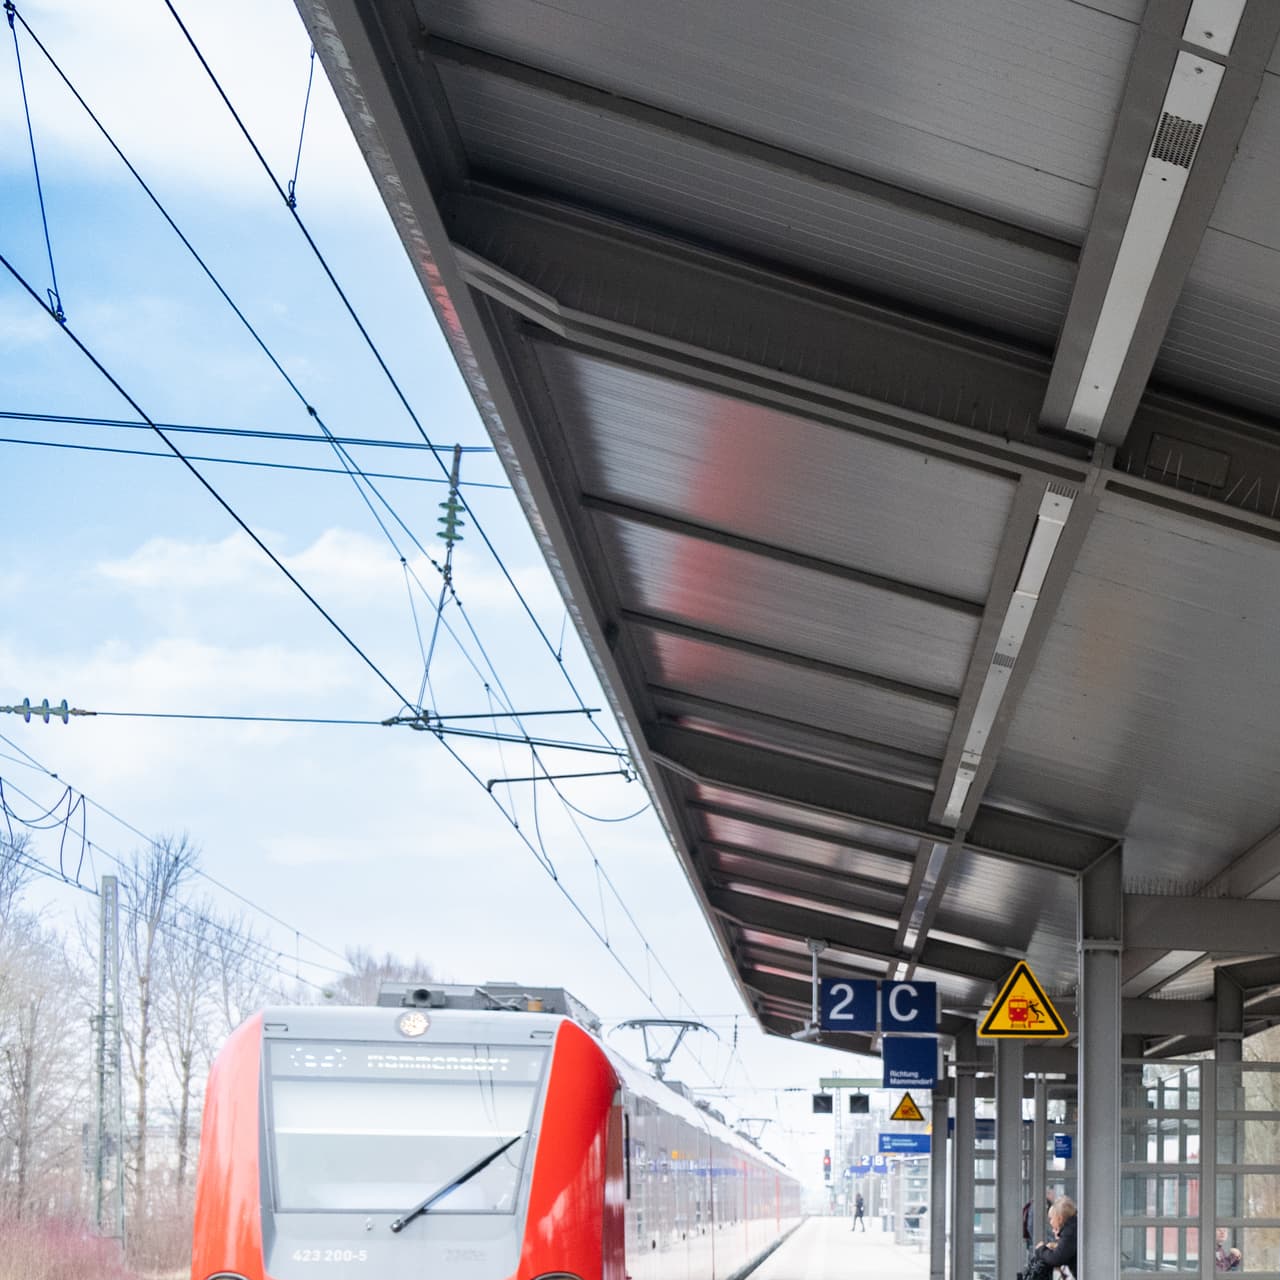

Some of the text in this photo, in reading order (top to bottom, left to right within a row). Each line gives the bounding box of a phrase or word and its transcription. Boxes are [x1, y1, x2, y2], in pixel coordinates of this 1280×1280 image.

[829, 983, 919, 1022] 2 C
[890, 1070, 918, 1078] Richtung
[862, 1156, 869, 1166] 2
[293, 1249, 368, 1262] 423 200-5
